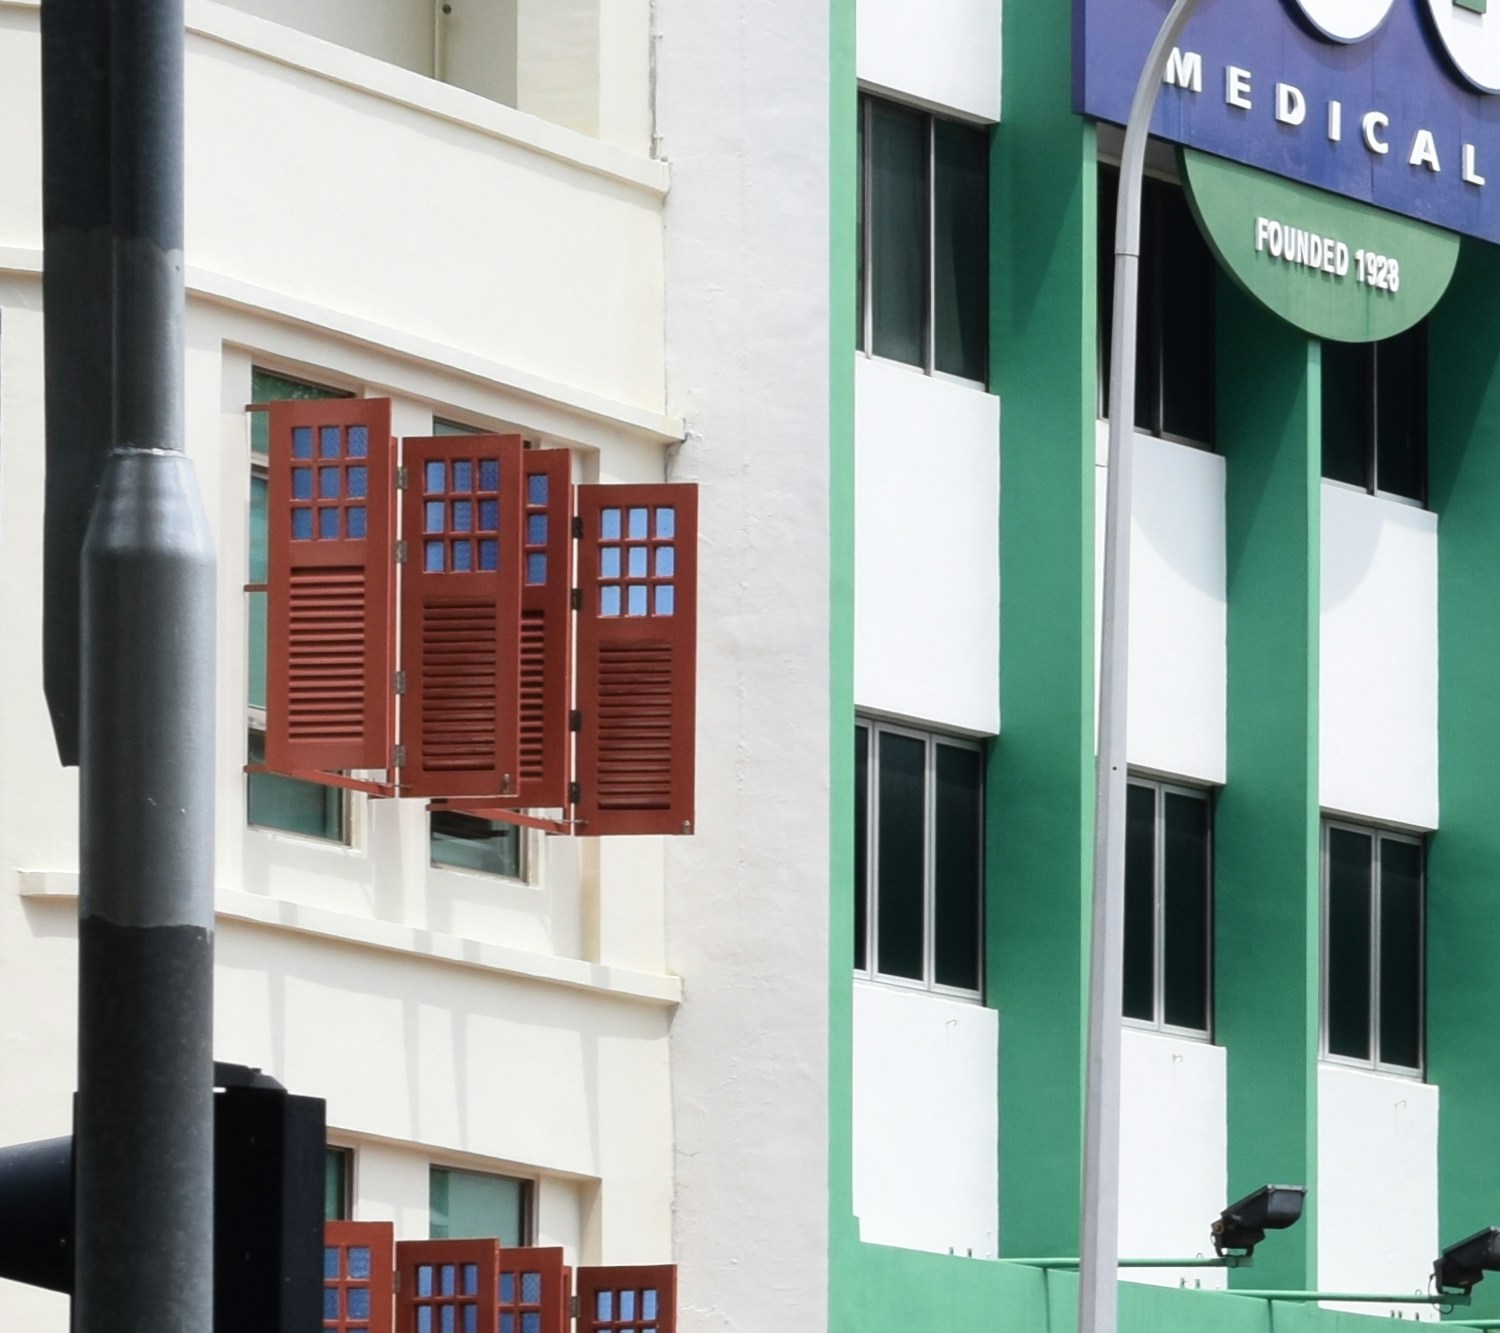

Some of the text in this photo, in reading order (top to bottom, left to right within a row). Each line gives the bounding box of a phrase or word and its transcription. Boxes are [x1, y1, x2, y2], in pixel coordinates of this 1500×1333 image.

[1163, 46, 1486, 186] MEDICAL
[1255, 216, 1400, 293] FOUNDED 1928
